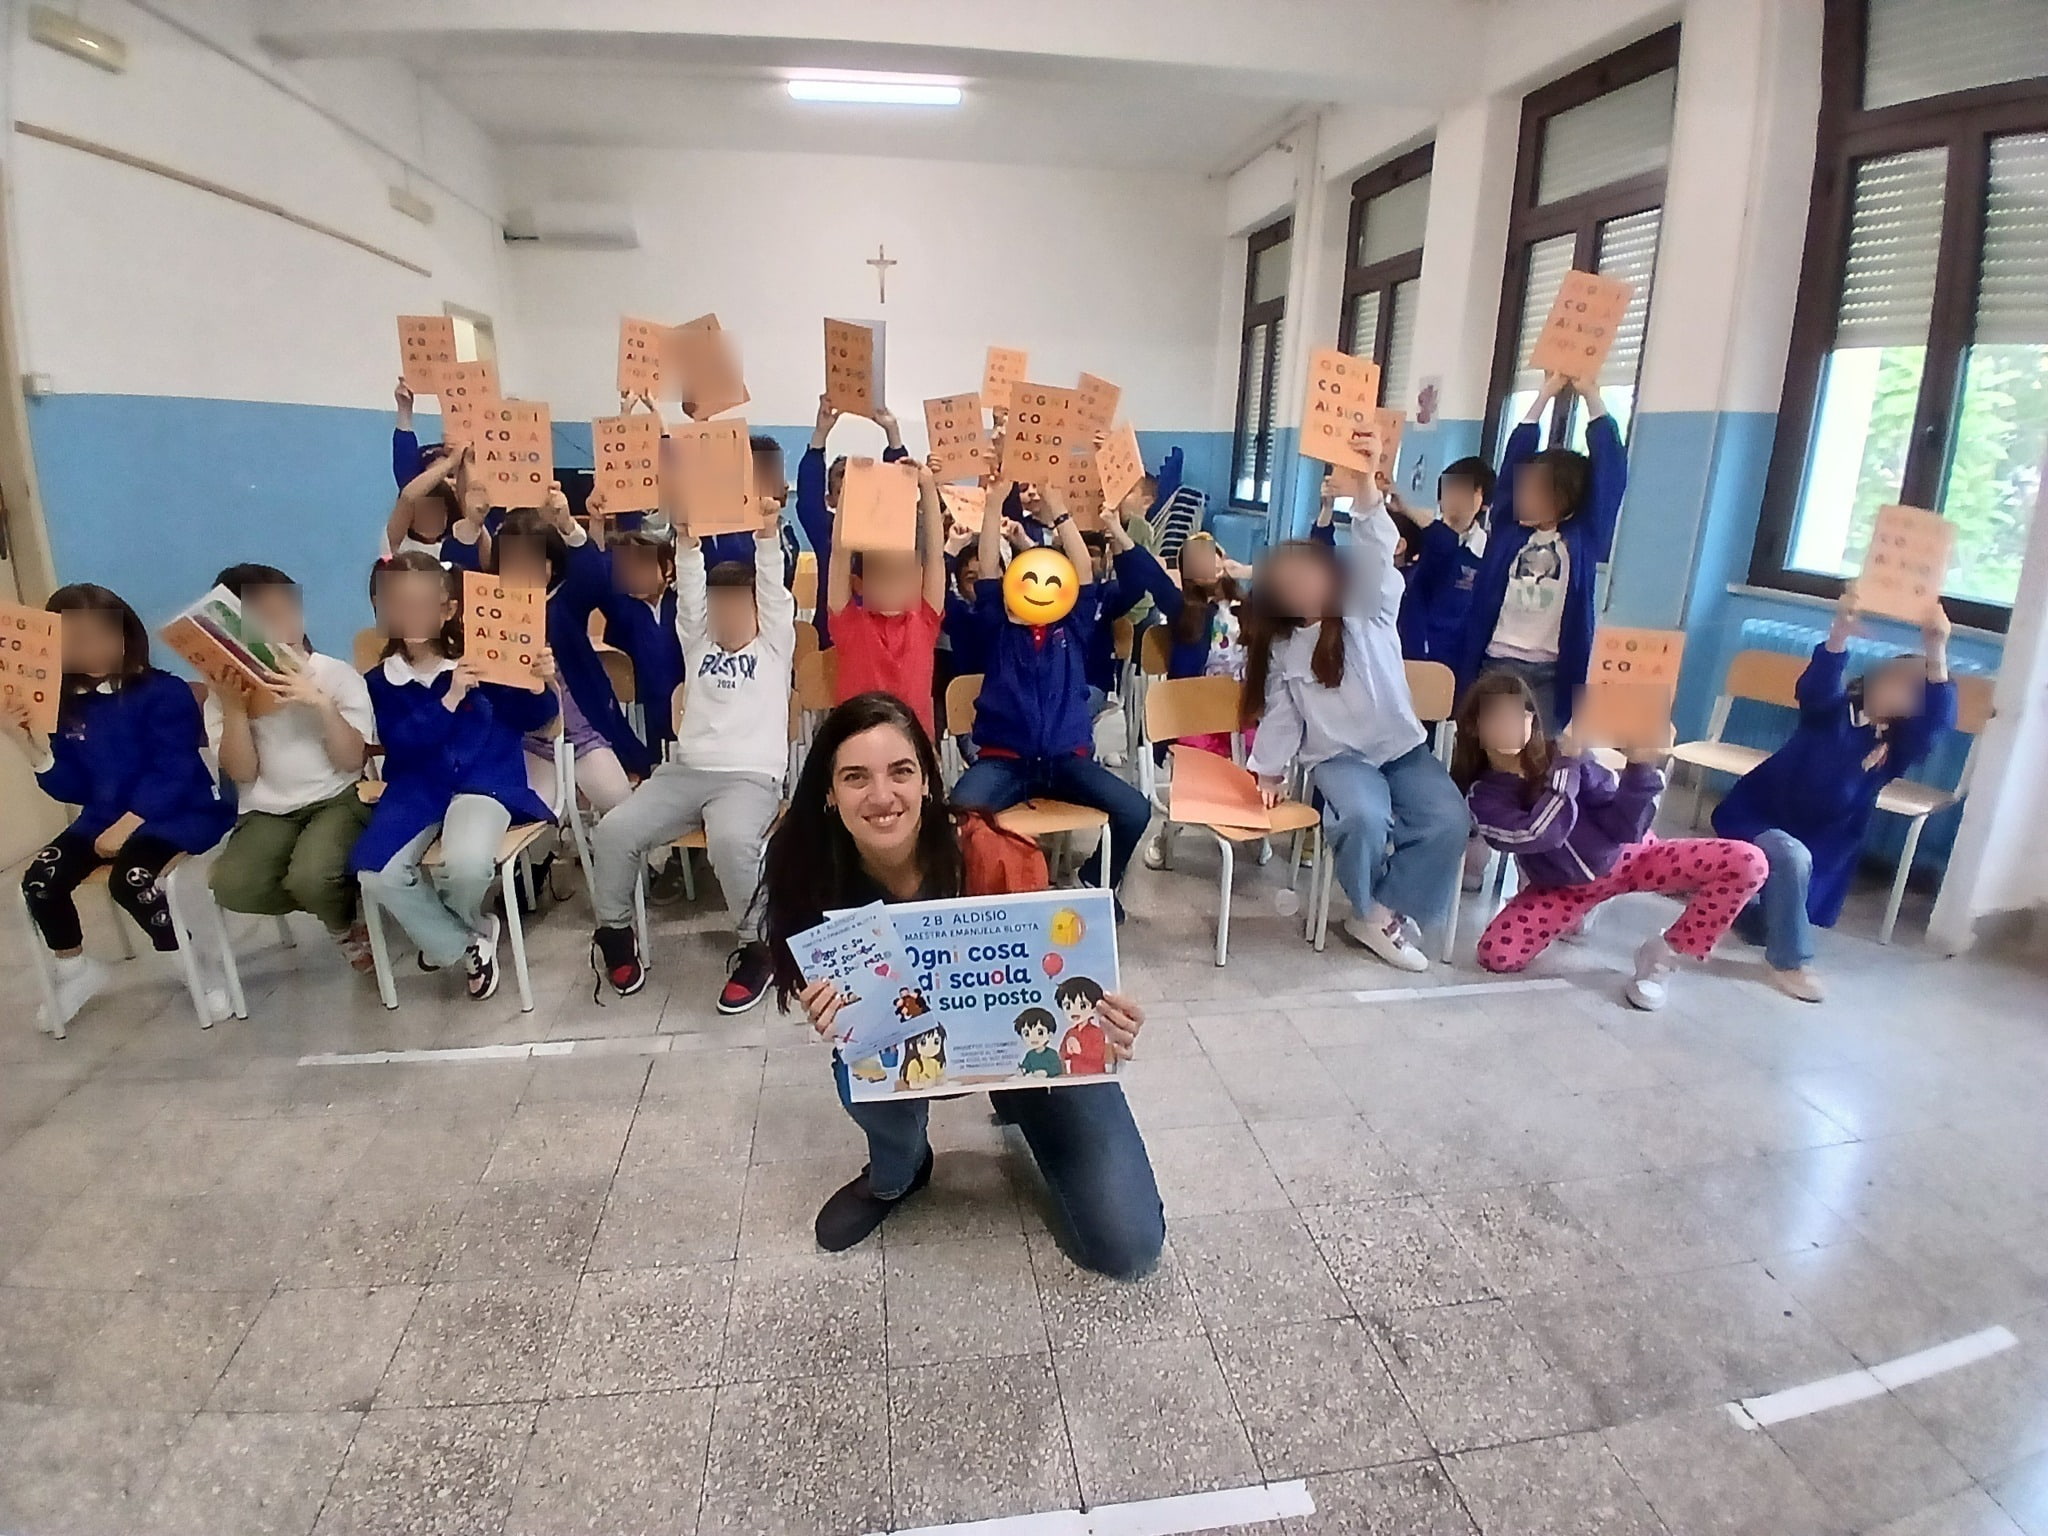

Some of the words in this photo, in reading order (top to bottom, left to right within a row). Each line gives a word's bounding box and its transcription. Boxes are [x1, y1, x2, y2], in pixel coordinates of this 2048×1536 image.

[1318, 379, 1366, 402] COA
[1018, 412, 1065, 428] COA
[485, 430, 538, 442] COA
[604, 441, 650, 453] COA
[476, 605, 532, 624] COA
[500, 630, 532, 645] SUO
[1602, 660, 1663, 675] COA
[717, 679, 736, 689] 2024
[922, 915, 931, 927] 2
[934, 915, 943, 926] B
[953, 909, 1007, 925] ALDISIO
[904, 930, 947, 941] MAESTRA
[950, 924, 1001, 938] EMANUELA
[968, 942, 1029, 962] cosa
[918, 971, 941, 992] di
[949, 964, 1032, 989] scuola
[938, 994, 977, 1011] suo
[984, 988, 1042, 1012] posto
